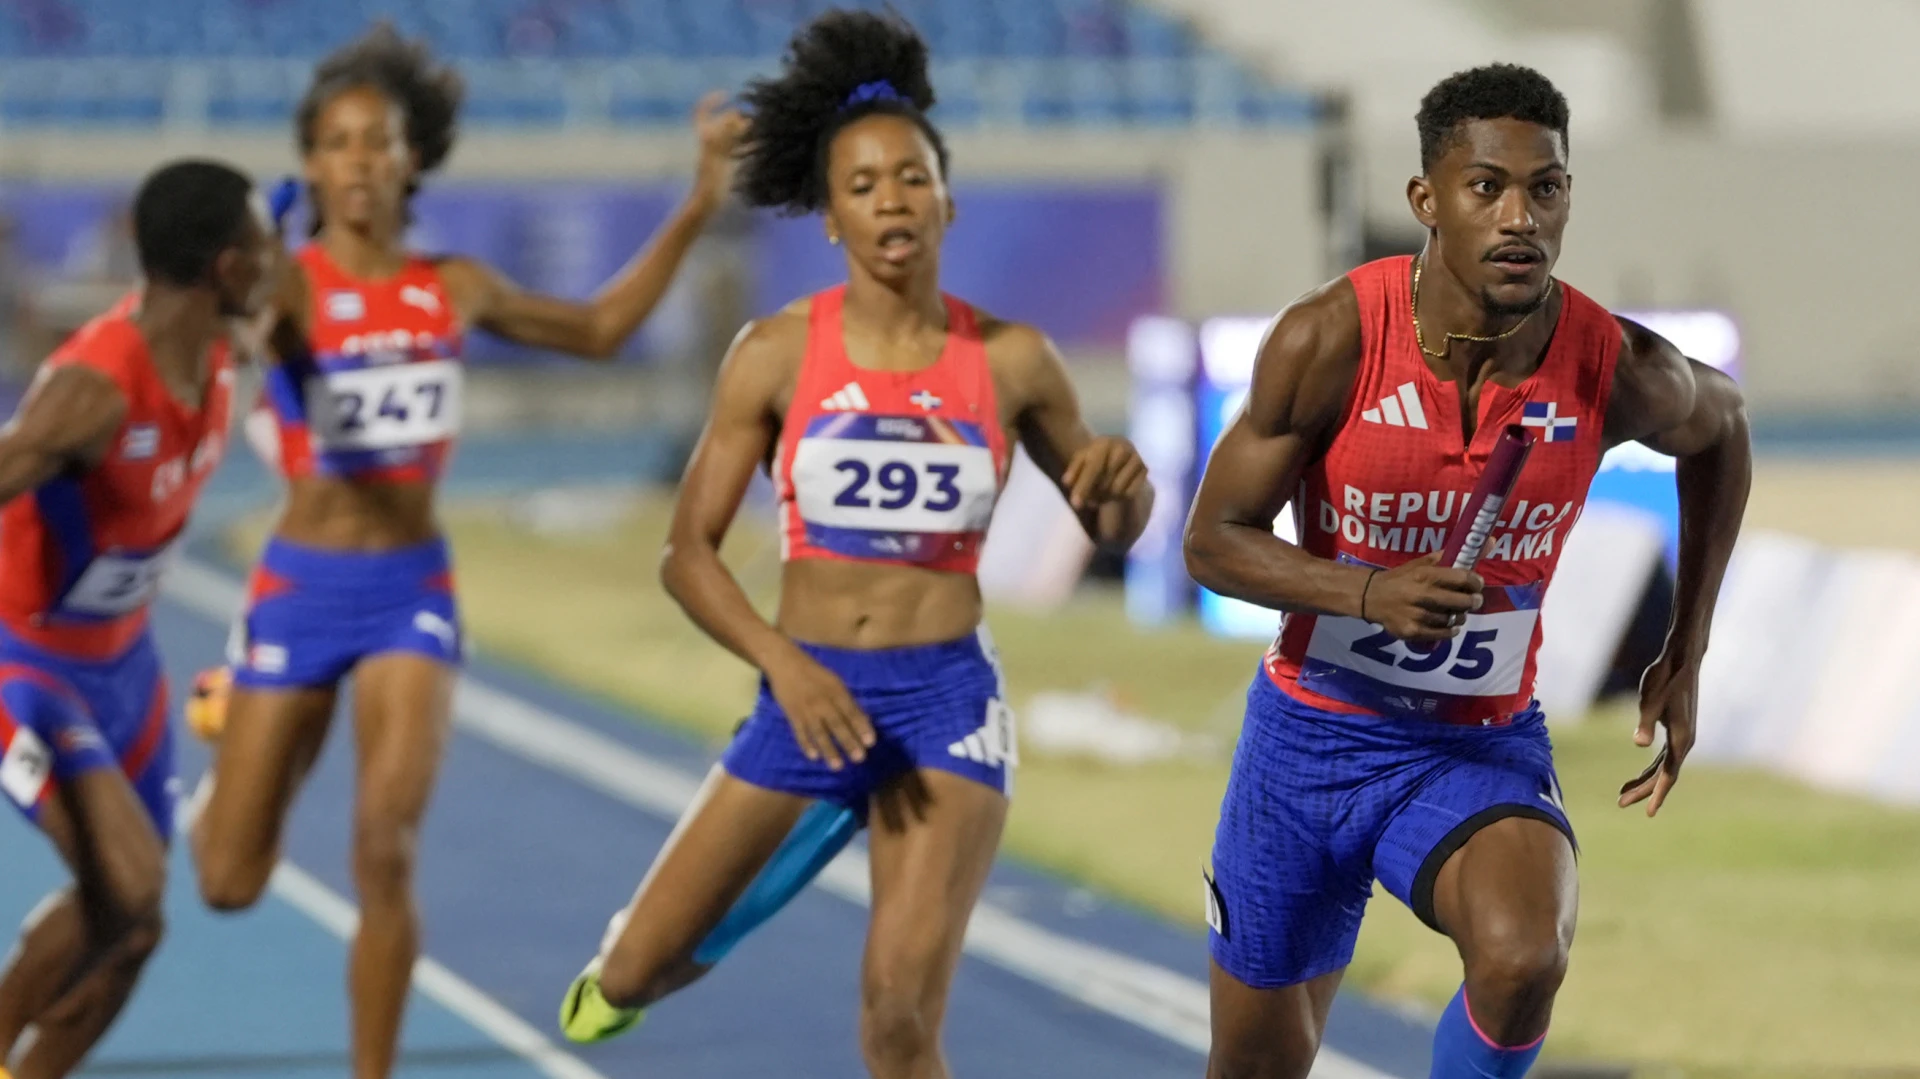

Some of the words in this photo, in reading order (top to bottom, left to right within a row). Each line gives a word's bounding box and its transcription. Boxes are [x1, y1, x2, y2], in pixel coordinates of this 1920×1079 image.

[333, 382, 444, 431] 247
[833, 459, 962, 512] 293
[1319, 499, 1557, 562] DOMINANA
